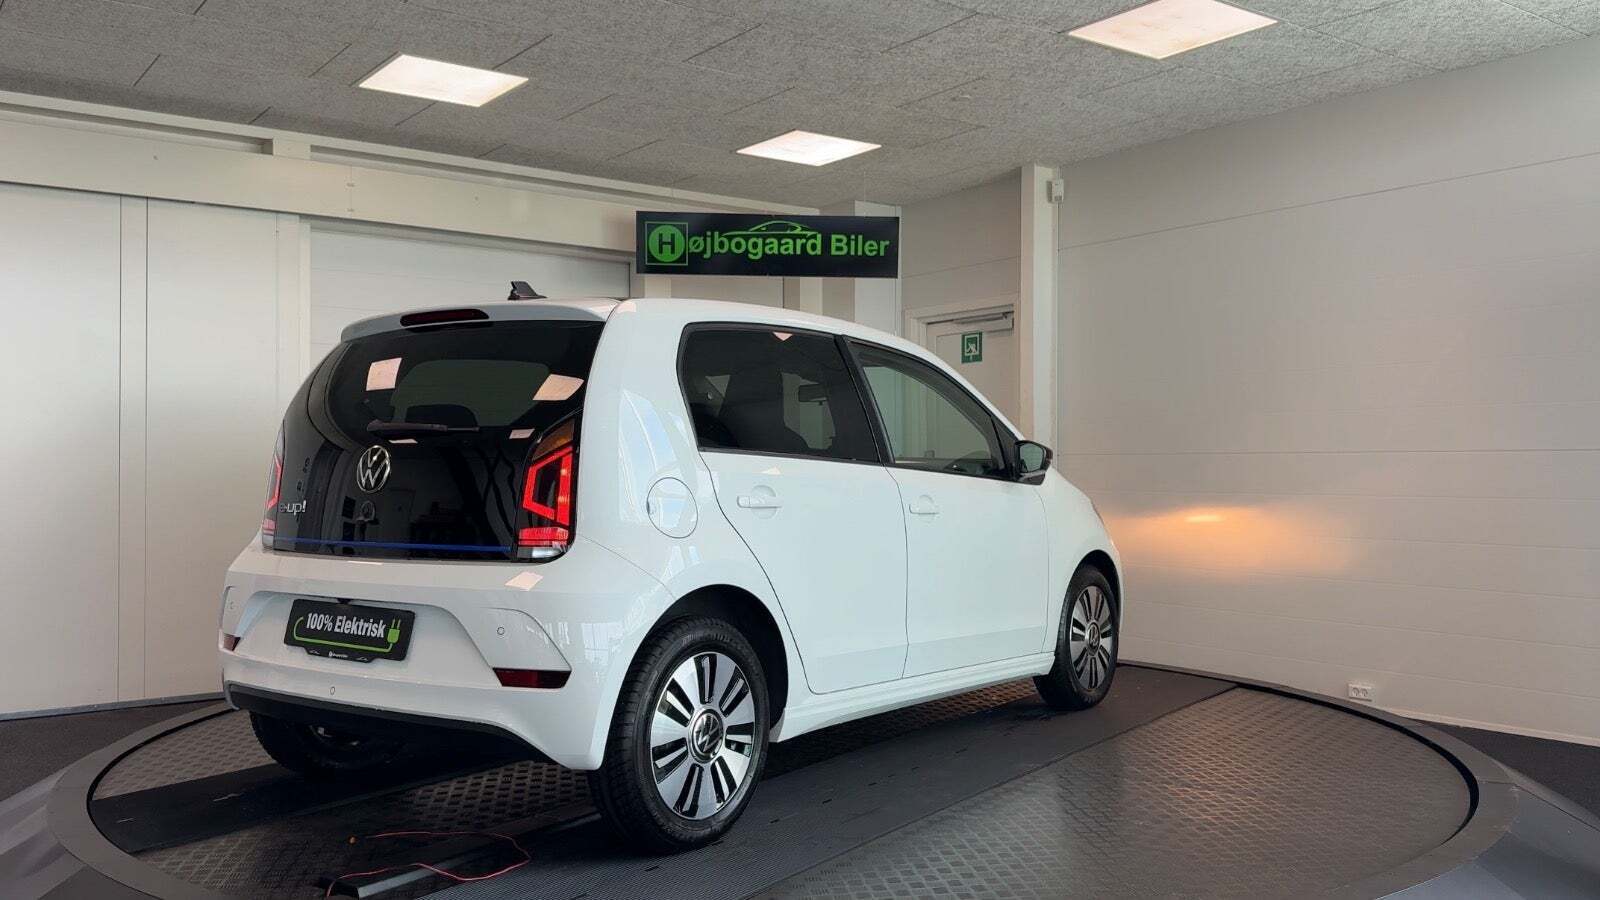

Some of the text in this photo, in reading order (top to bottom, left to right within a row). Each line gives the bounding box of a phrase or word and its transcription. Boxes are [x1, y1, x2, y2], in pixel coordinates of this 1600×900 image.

[656, 230, 890, 260] Højbogaard Biler
[306, 612, 387, 638] 100% Elektrisk
